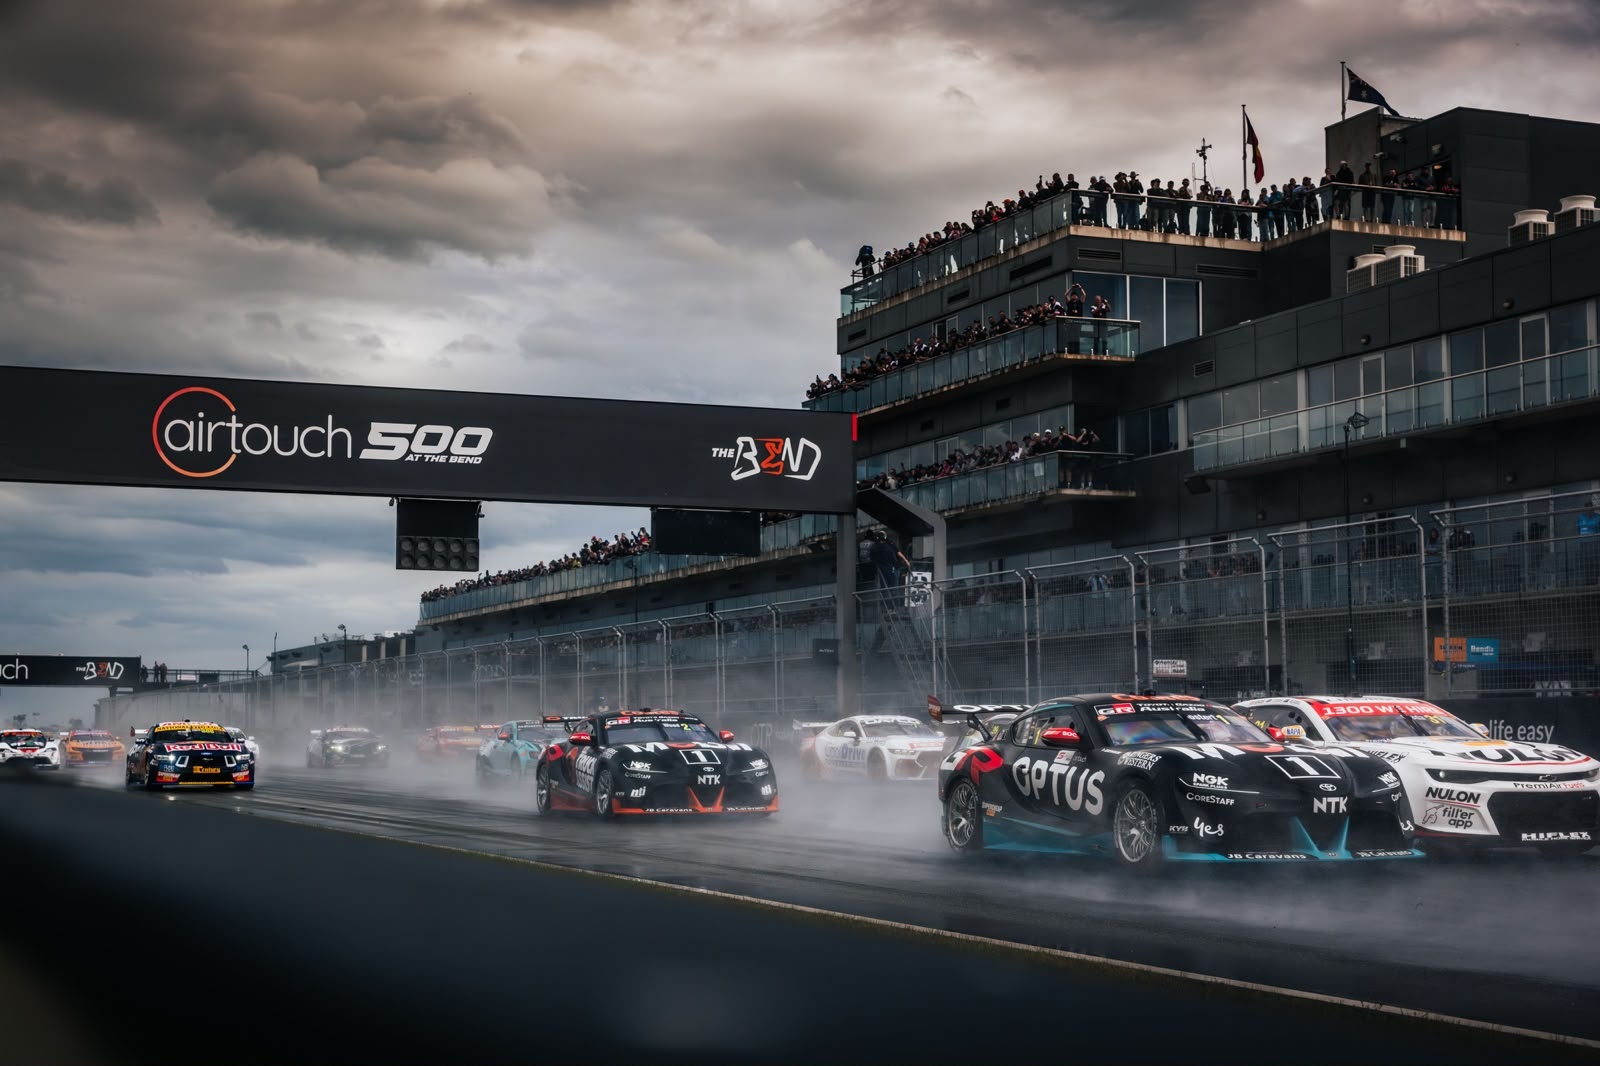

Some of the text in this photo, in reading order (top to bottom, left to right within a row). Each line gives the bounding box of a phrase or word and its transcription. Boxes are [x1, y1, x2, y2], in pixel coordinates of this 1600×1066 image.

[164, 412, 493, 460] airtouch 500
[405, 454, 482, 464] AT THE BEND
[711, 447, 735, 458] THE
[1323, 705, 1373, 715] 1300
[1516, 725, 1554, 744] easy
[164, 742, 242, 753] Red Bull
[691, 750, 708, 763] 1
[1285, 756, 1320, 776] 1
[697, 774, 720, 785] NTK
[1012, 756, 1106, 815] OPTUS
[1193, 772, 1229, 786] NGK
[1425, 786, 1481, 804] NULON
[1313, 796, 1348, 814] NTK
[1442, 806, 1474, 820] fill'er
[1448, 817, 1473, 829] app
